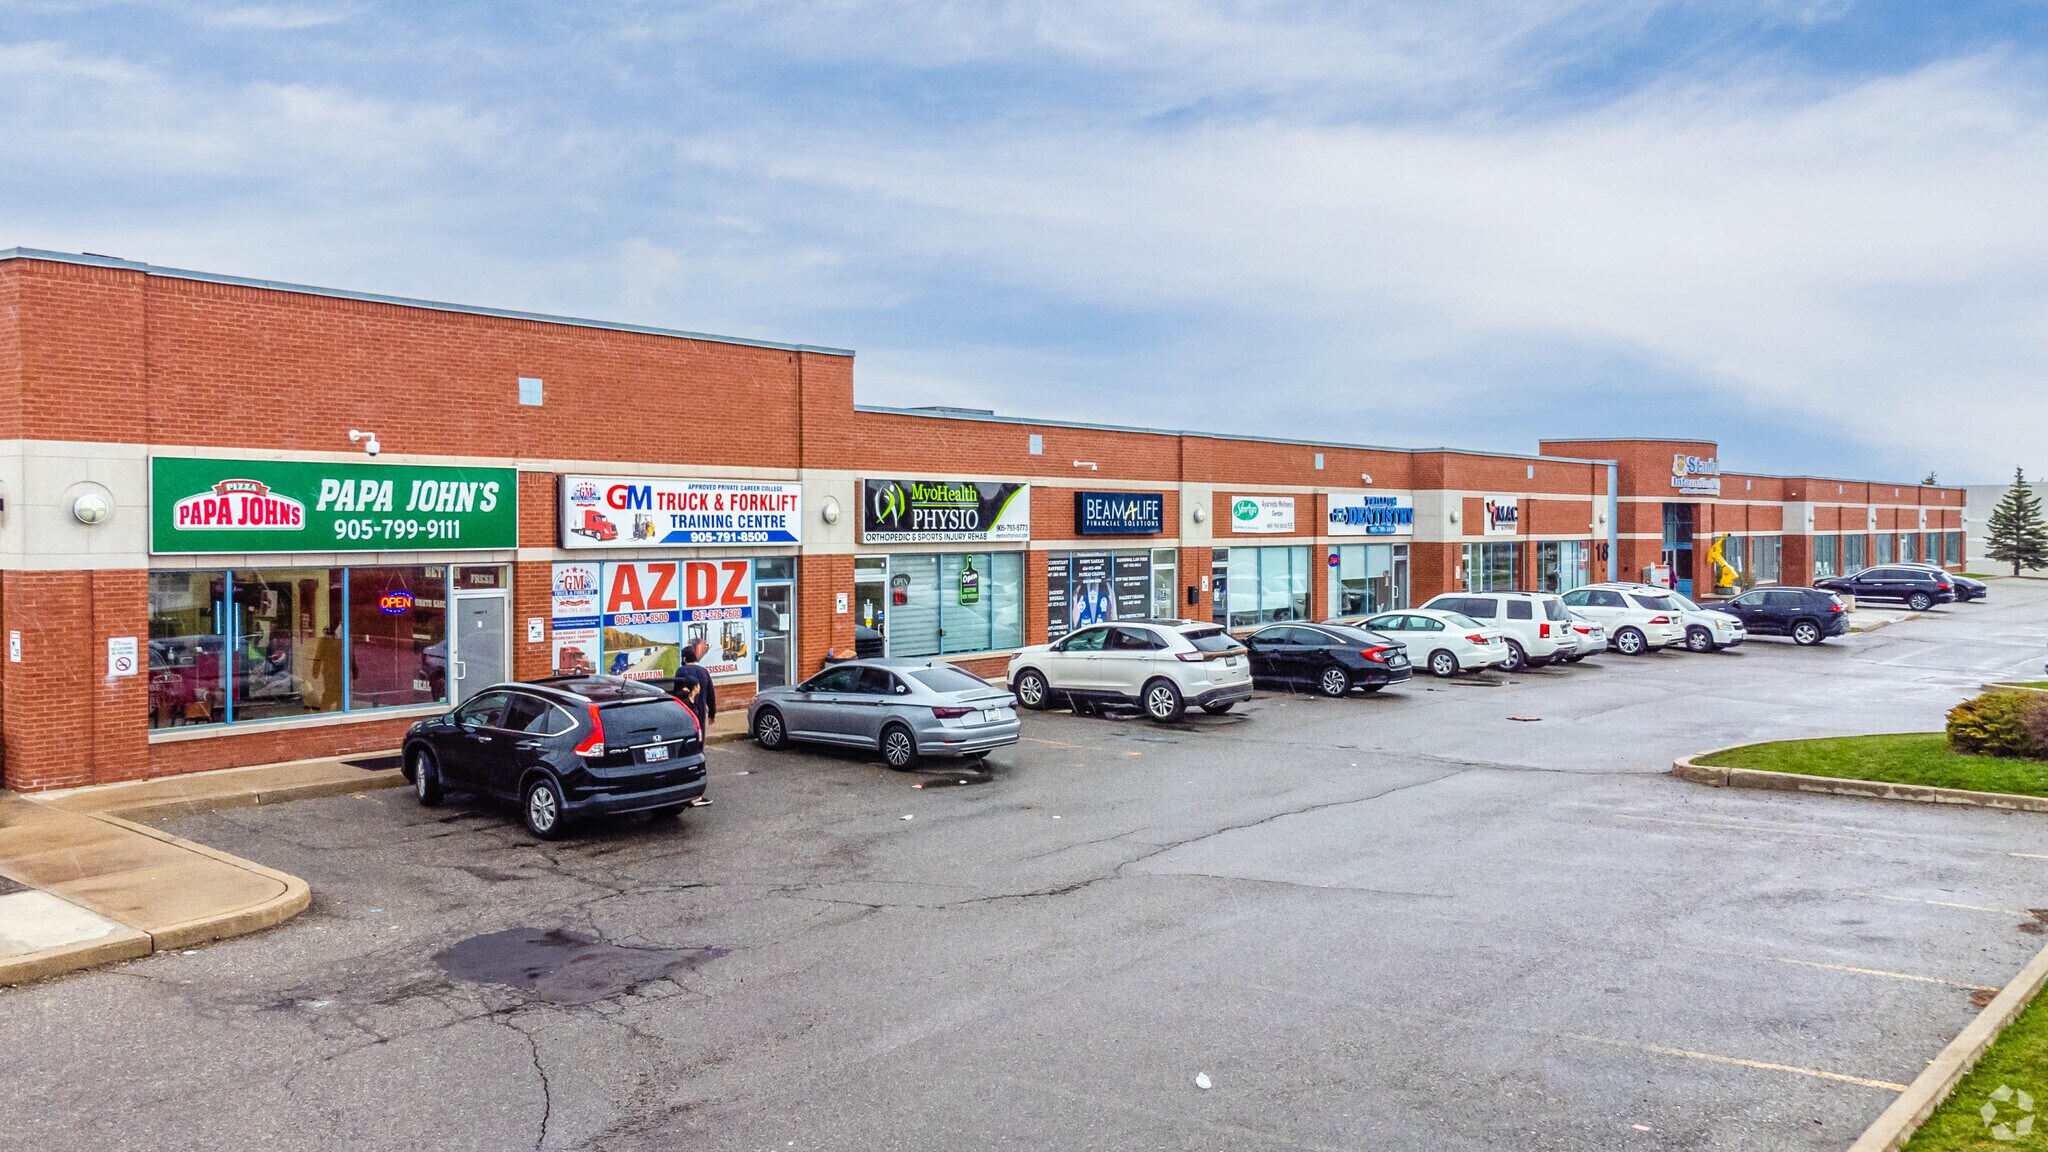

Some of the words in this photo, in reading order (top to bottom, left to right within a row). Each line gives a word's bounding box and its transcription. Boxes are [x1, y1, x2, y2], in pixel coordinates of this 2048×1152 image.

[226, 483, 258, 491] PIZZA
[580, 487, 593, 497] GM
[911, 484, 977, 503] MyoHealth
[316, 479, 393, 512] PAPA
[406, 480, 500, 512] JOHN'S
[606, 484, 652, 510] GM
[657, 492, 709, 511] TRUCK
[714, 493, 724, 511] &
[730, 494, 798, 511] FORKLIFT
[179, 497, 233, 525] PAPA
[238, 497, 301, 525] JOHN'S
[1345, 507, 1413, 525] DENTISTRY
[670, 514, 733, 528] TRAINING
[738, 514, 786, 528] CENTRE
[912, 509, 979, 530] PHYSIO
[334, 519, 460, 540] 905-799-9111
[996, 524, 1028, 532] 905-793-5773
[690, 532, 769, 542] 905-791-8500
[866, 533, 911, 542] ORTHOPEDIC
[912, 533, 917, 541] &
[918, 533, 943, 541] SPORTS
[1596, 543, 1609, 561] 18
[564, 575, 584, 590] GM
[686, 561, 749, 607] DZ
[893, 577, 908, 586] OPEN
[962, 573, 977, 584] Open
[606, 563, 677, 612] AZ
[381, 597, 412, 608] OPEN
[614, 612, 669, 625] 905-791-8500
